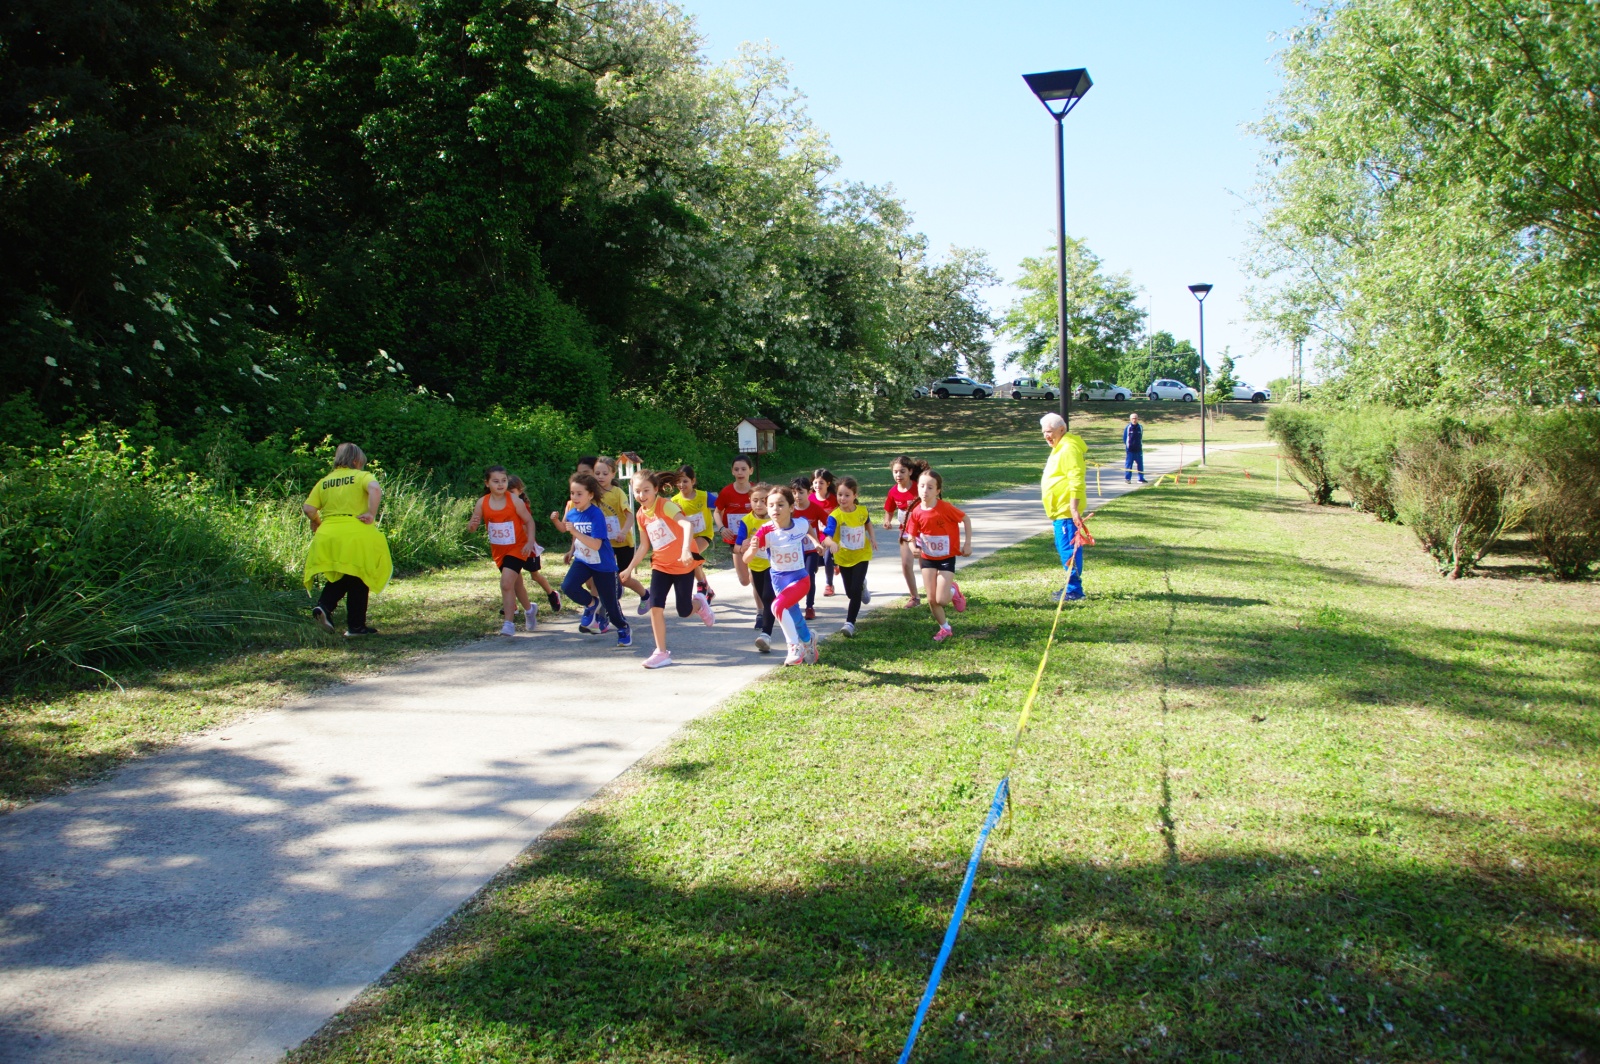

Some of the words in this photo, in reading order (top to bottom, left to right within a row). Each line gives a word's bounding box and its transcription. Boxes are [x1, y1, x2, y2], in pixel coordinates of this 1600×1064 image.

[322, 476, 355, 490] GIUDICE
[491, 529, 511, 539] 253
[649, 527, 667, 542] 252
[846, 533, 861, 543] 117
[776, 551, 799, 564] 259
